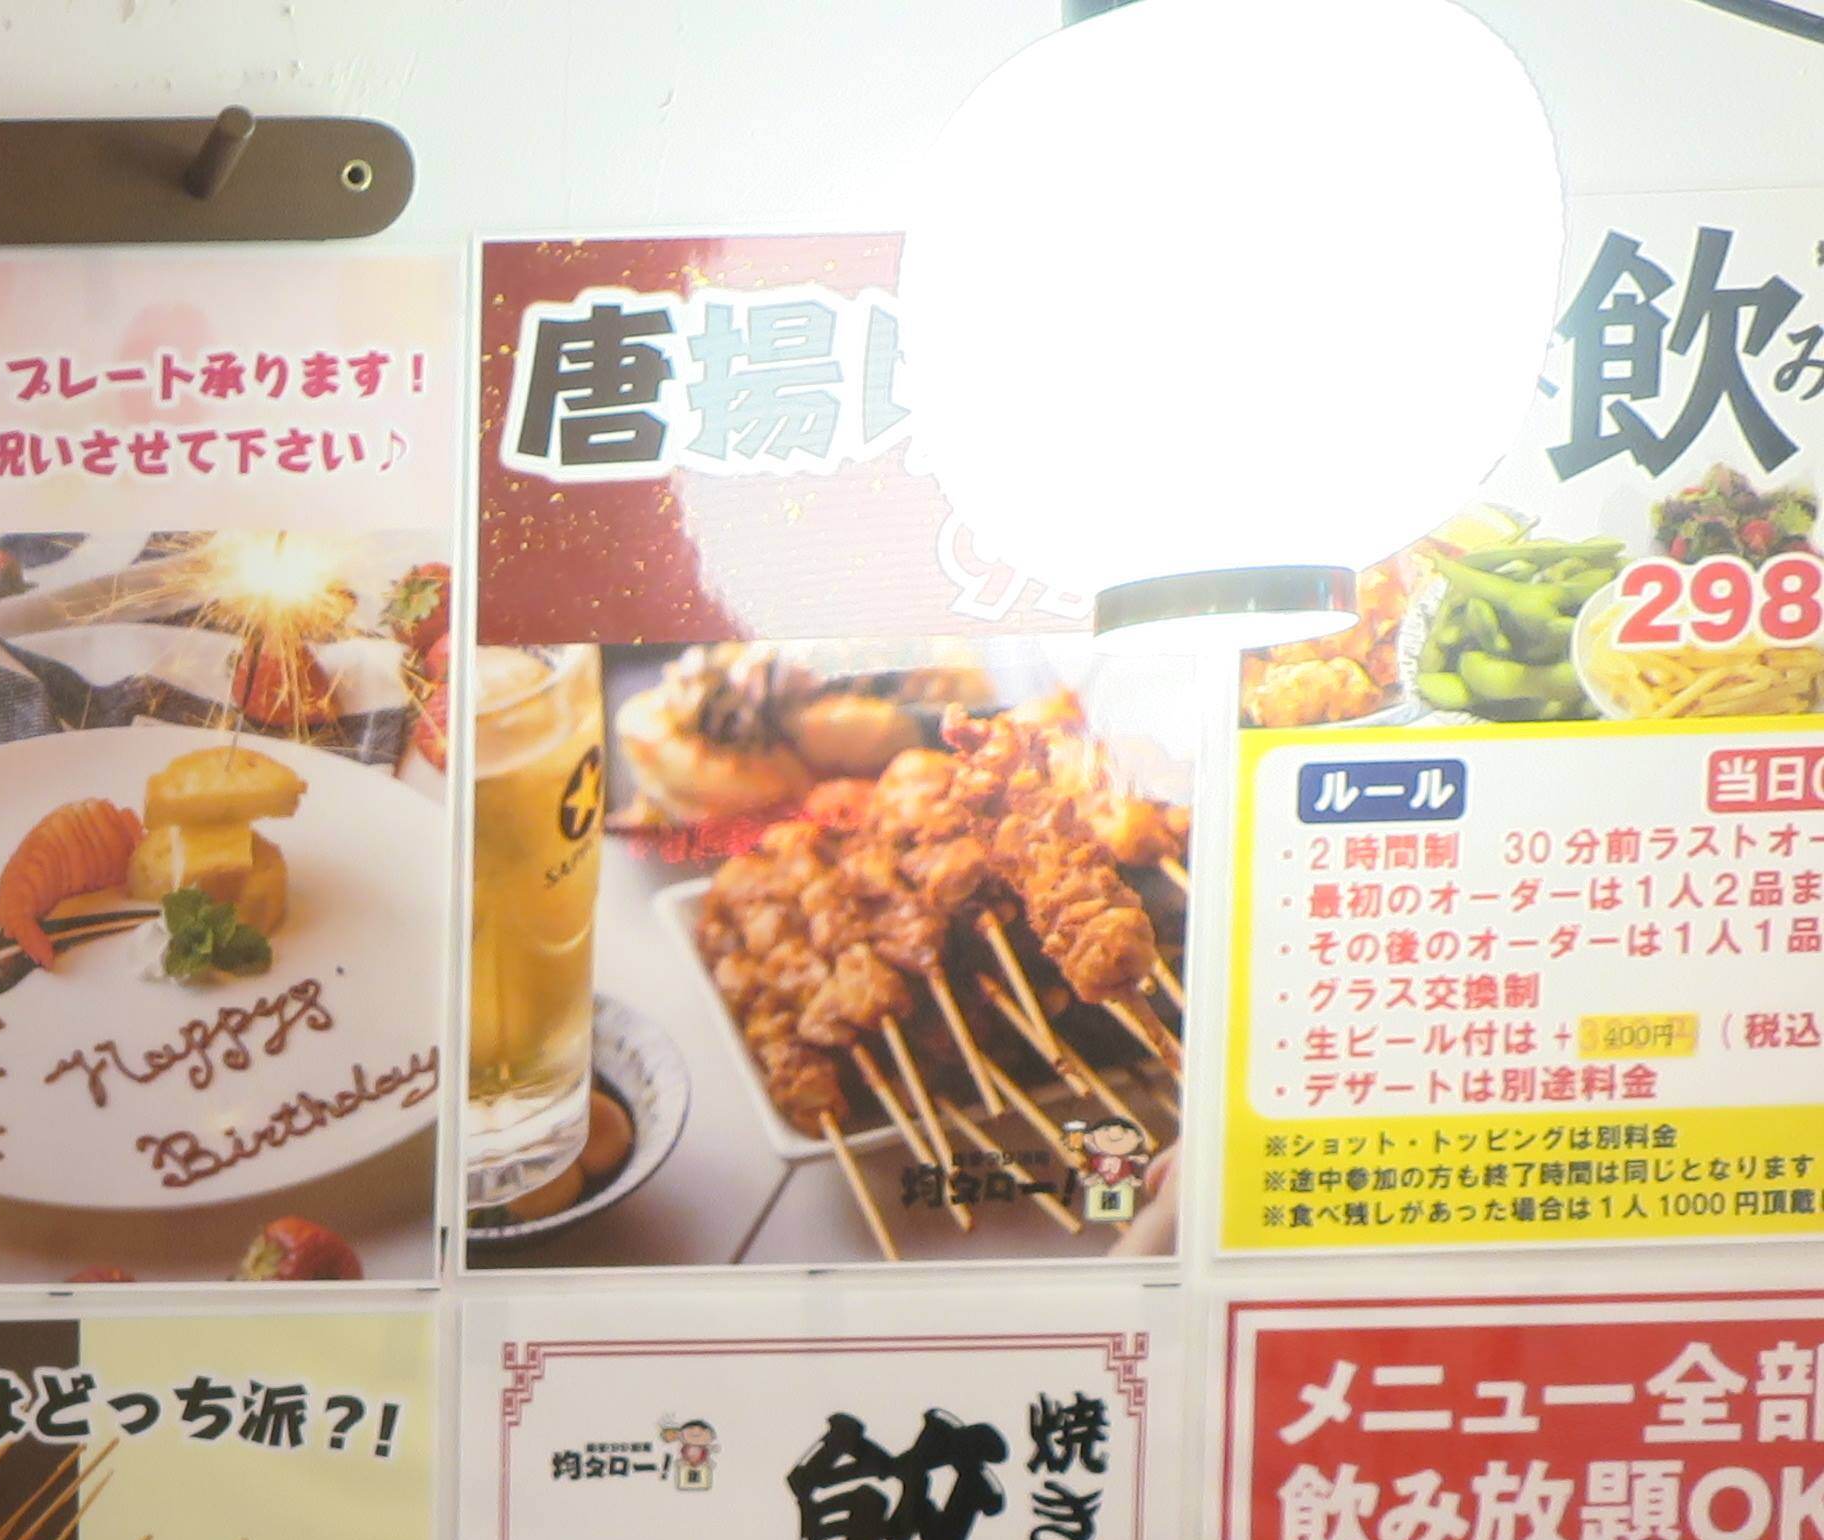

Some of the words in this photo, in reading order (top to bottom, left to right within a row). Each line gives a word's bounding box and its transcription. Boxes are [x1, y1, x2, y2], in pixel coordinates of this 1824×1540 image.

[1618, 558, 1822, 643] 298
[1314, 765, 1456, 813] ルール
[1309, 832, 1461, 871] 2時間制
[1308, 972, 1541, 1013] グラス交換制
[44, 977, 336, 1108] Happy
[1303, 1064, 1659, 1106] デザートは別途料金
[135, 1045, 441, 1190] Birthday
